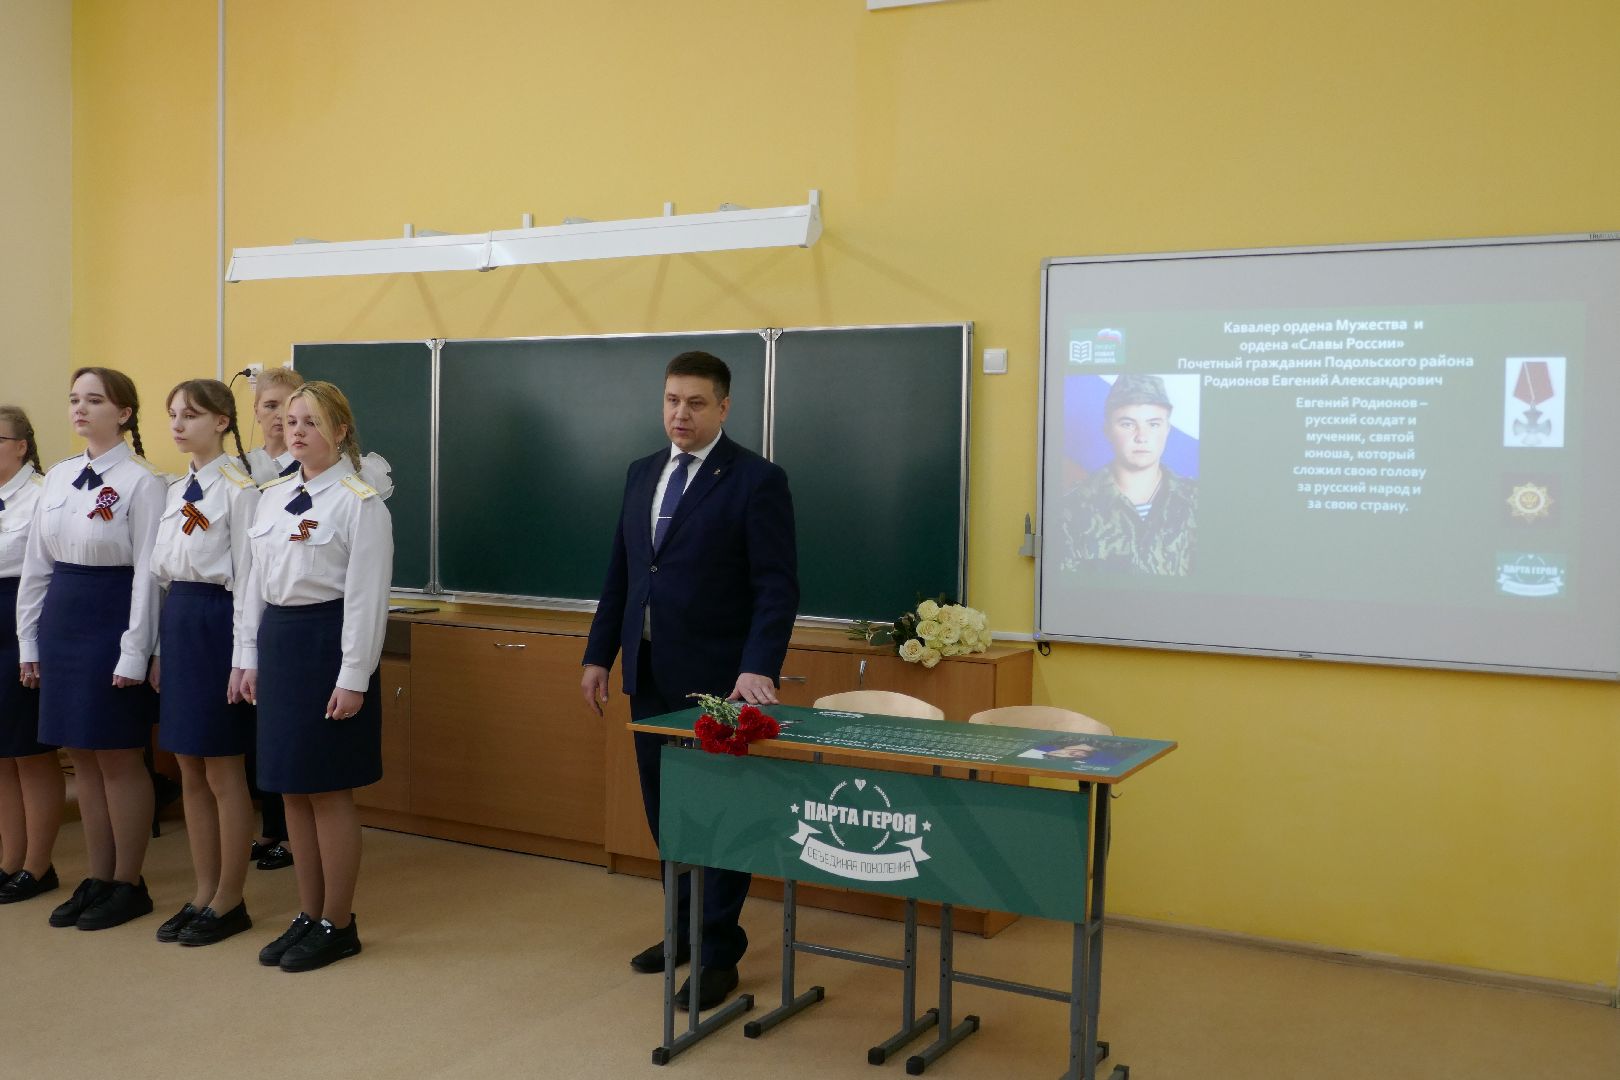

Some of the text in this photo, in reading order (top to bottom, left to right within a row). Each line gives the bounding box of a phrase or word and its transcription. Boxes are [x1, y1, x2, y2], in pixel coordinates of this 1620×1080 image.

[1224, 319, 1424, 335] Кавалер ордена Мужества и
[1240, 337, 1405, 354] ордена «Славы России»
[1178, 353, 1474, 372] Почетный гражданин Подольского района
[1204, 373, 1443, 389] Родионов Евгений Александрович
[1296, 396, 1350, 408] Евгений
[1352, 397, 1418, 410] Родионов
[1305, 413, 1417, 428] русский солдат и
[1306, 430, 1415, 445] мученик, святой
[1304, 448, 1416, 463] юноша, который
[1293, 466, 1427, 480] сложил свою голову
[1297, 482, 1421, 497] за русский народ и
[1307, 500, 1409, 515] за свою страну.
[804, 800, 916, 834] ПАРТА ГЕРОЯ
[860, 860, 911, 874] ПОКОЛЕНИЯ
